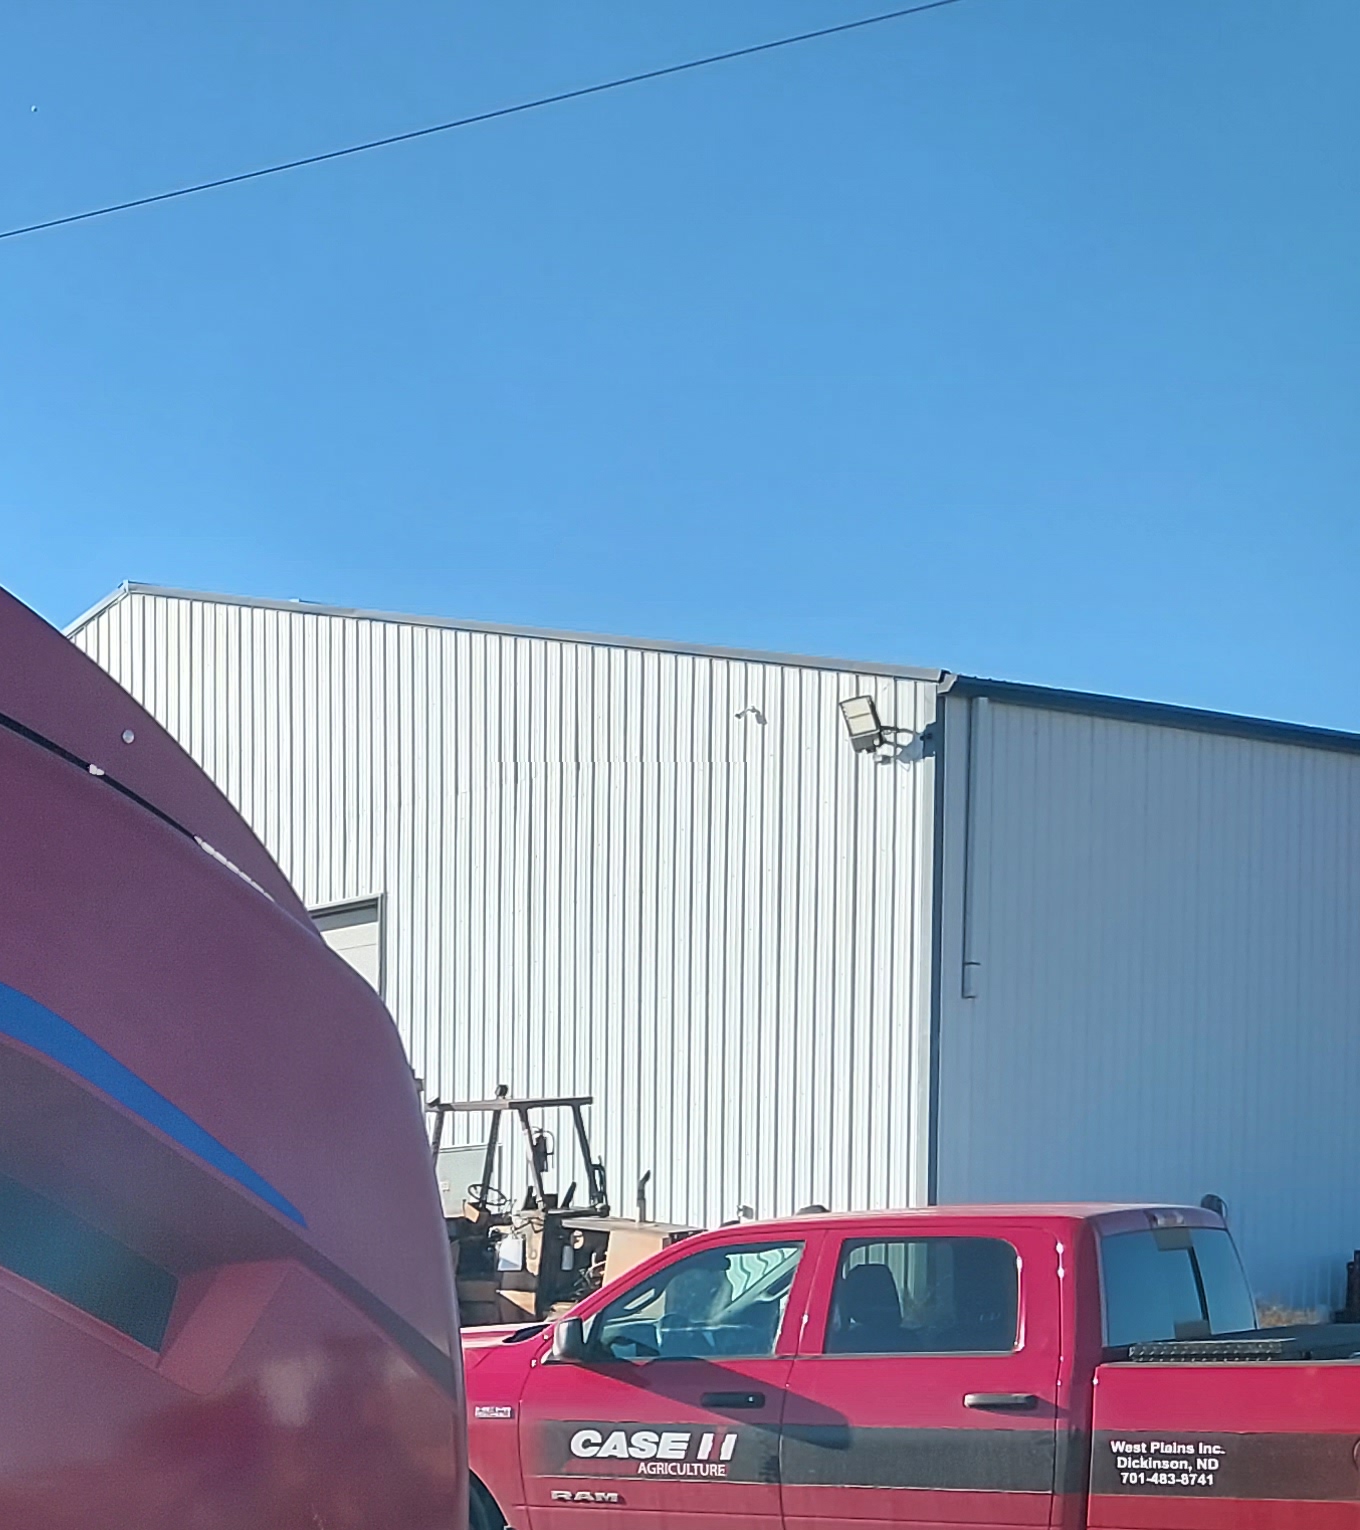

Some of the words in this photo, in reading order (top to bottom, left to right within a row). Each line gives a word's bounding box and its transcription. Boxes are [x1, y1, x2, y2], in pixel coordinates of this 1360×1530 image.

[570, 1429, 692, 1460] CASE
[1110, 1440, 1147, 1454] West
[1150, 1441, 1195, 1454] Plains
[1198, 1442, 1226, 1455] Inc.
[637, 1462, 727, 1477] AGRICULTURE
[1116, 1455, 1193, 1473] Dickinson,
[1196, 1458, 1220, 1471] ND
[1120, 1472, 1214, 1486] 701-483-8741
[550, 1490, 619, 1503] RAM
